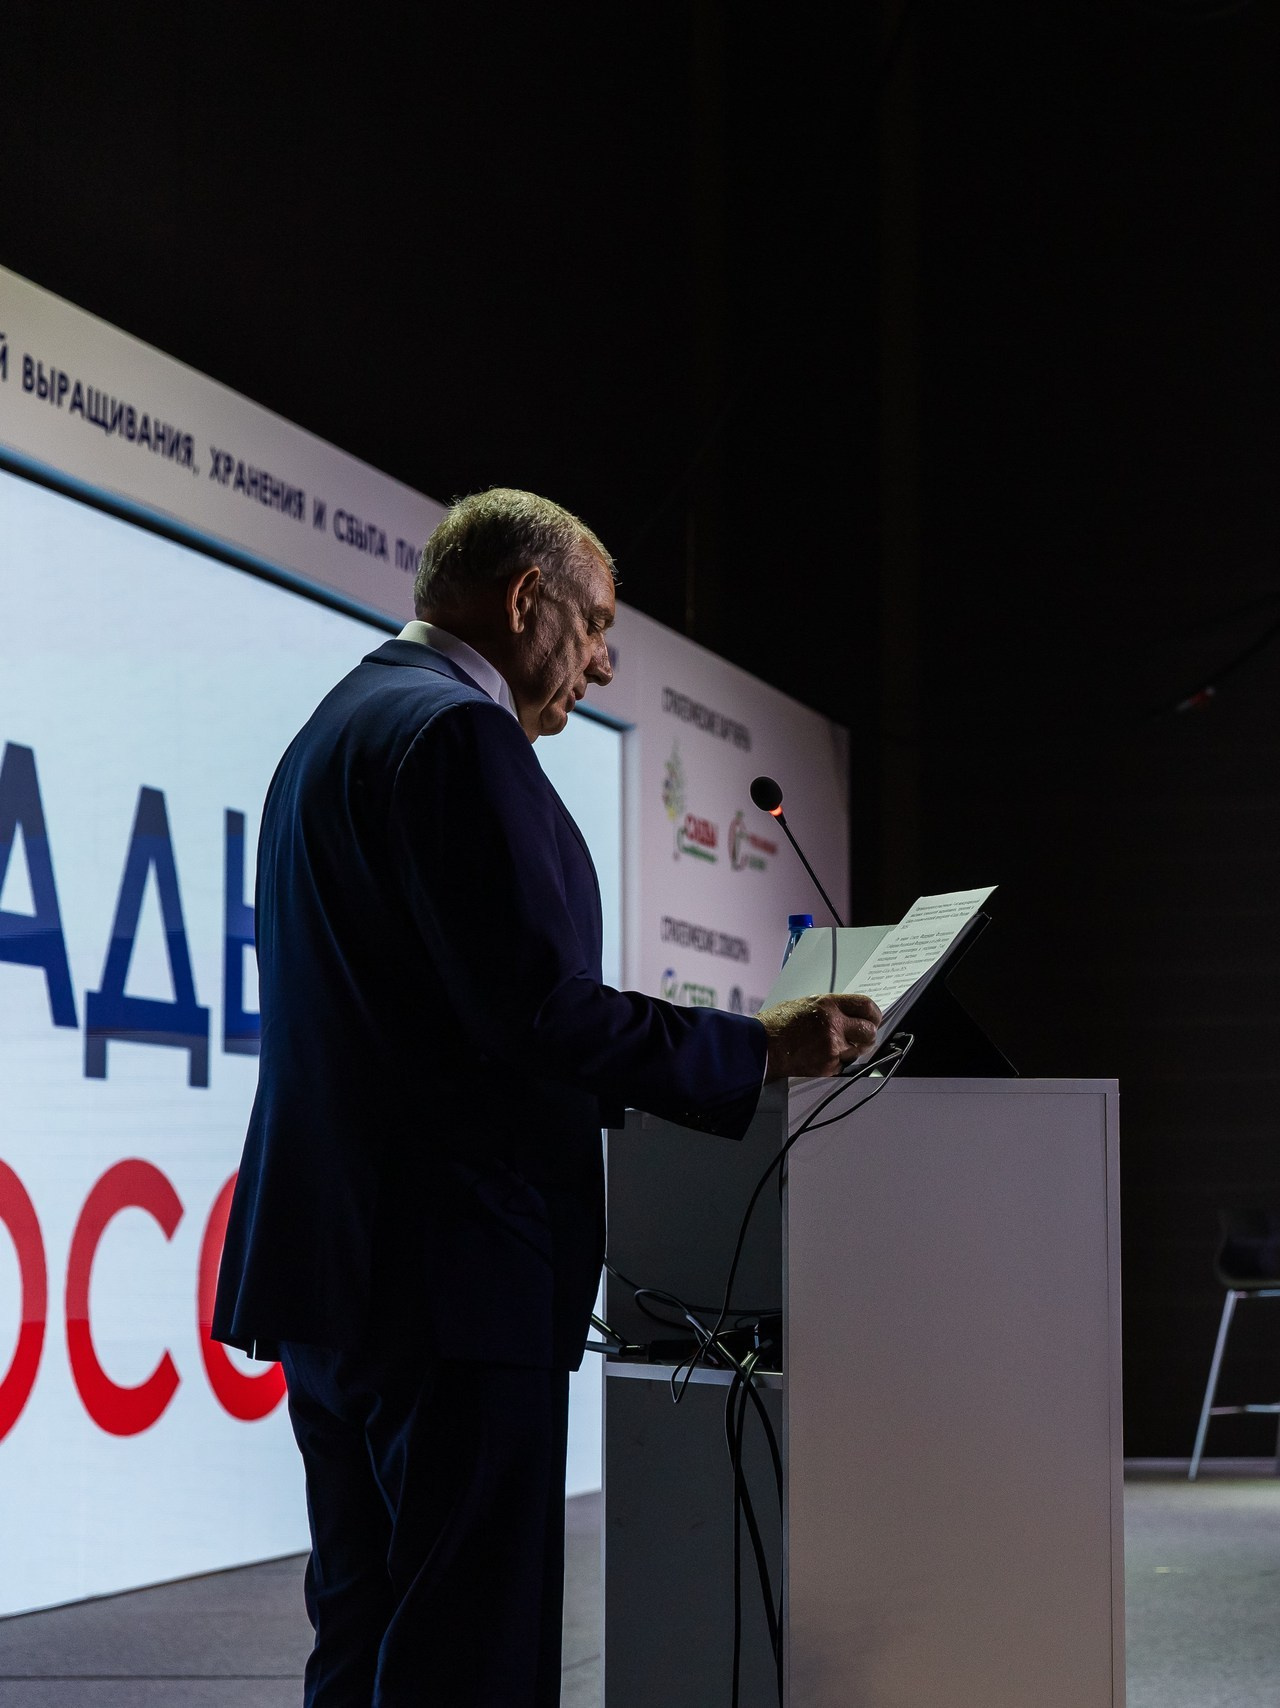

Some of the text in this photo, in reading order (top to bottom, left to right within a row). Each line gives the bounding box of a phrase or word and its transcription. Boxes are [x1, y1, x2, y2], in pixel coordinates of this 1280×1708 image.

[22, 353, 200, 476] ВЫРАЩИВАНИЯ,
[208, 446, 306, 525] ХРАНЕНИЯ
[312, 498, 327, 532] И
[333, 508, 390, 563] СБЫТА
